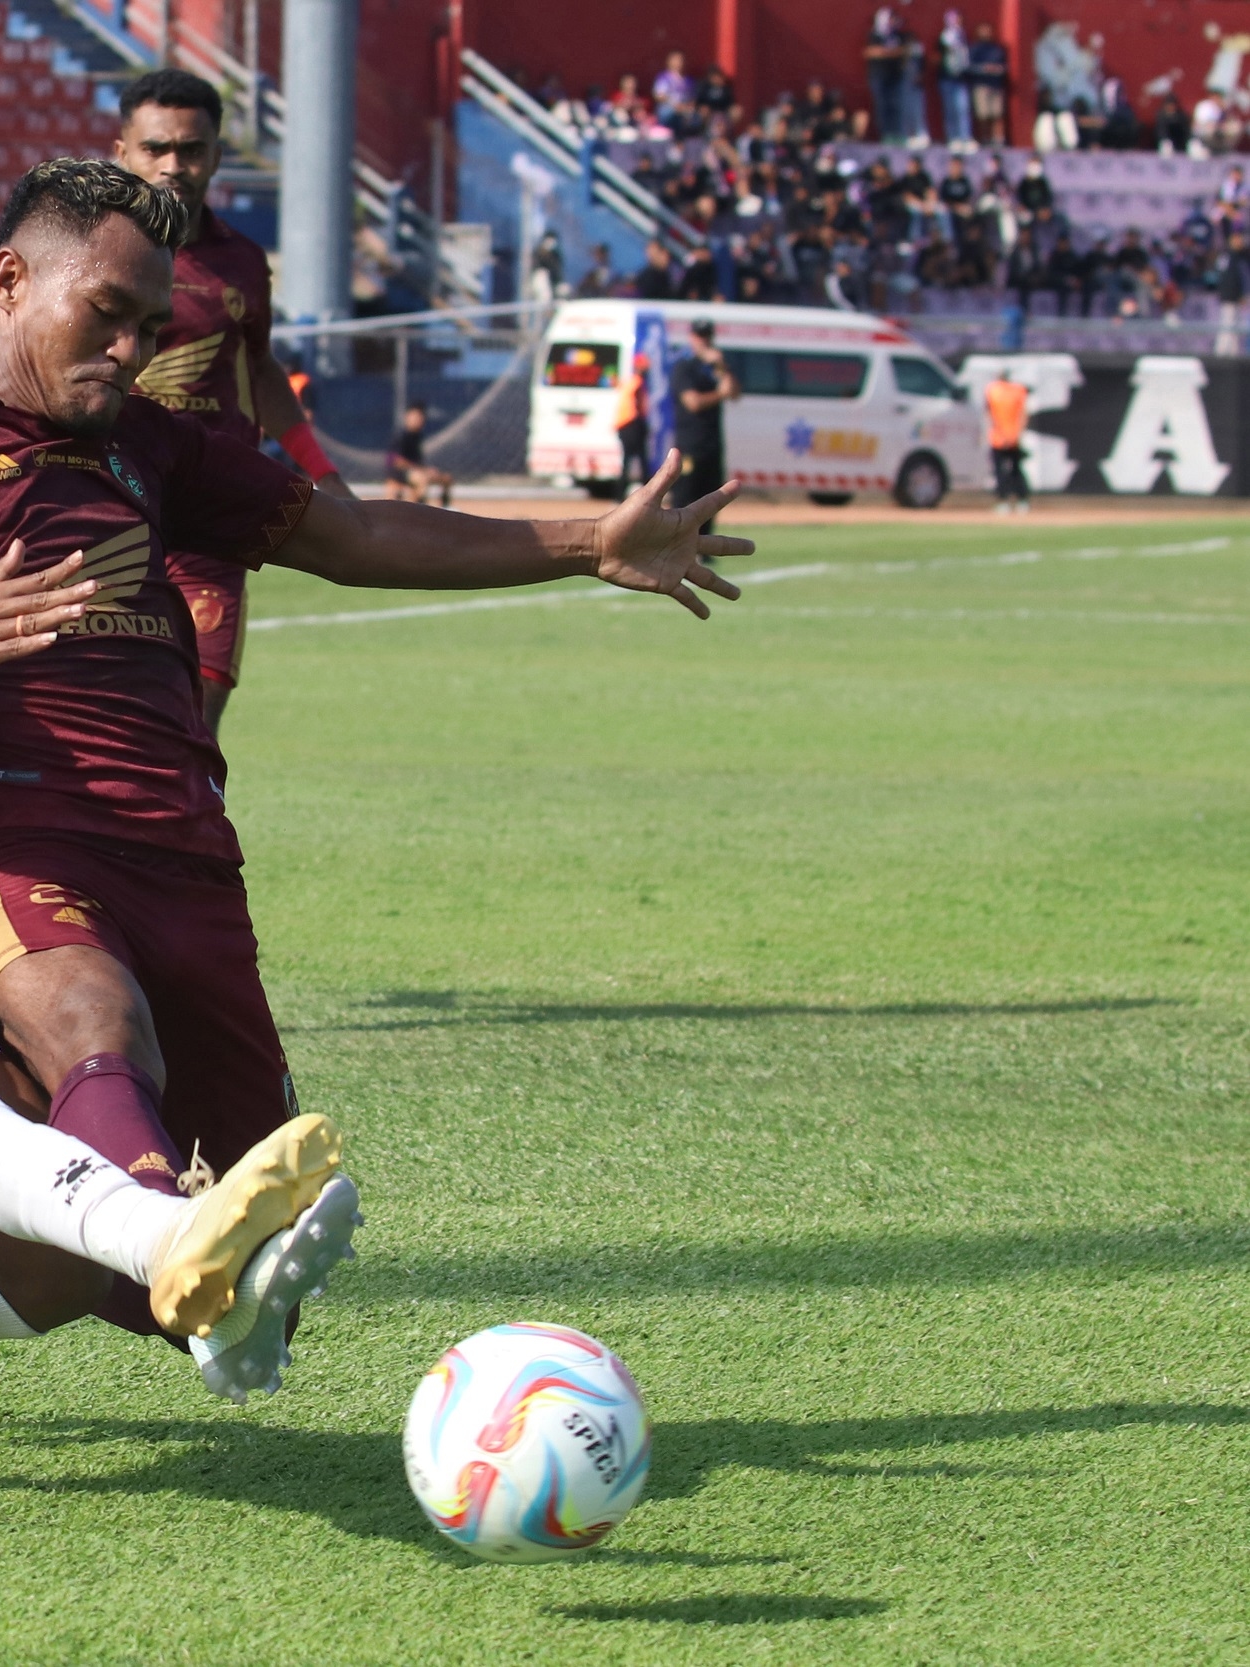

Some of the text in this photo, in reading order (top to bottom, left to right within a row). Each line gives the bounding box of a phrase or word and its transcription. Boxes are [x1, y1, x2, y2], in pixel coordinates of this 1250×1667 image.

[149, 393, 222, 411] ONDA
[67, 455, 101, 468] MOTOR
[57, 612, 174, 639] HONDA
[563, 1413, 620, 1485] SPECS
